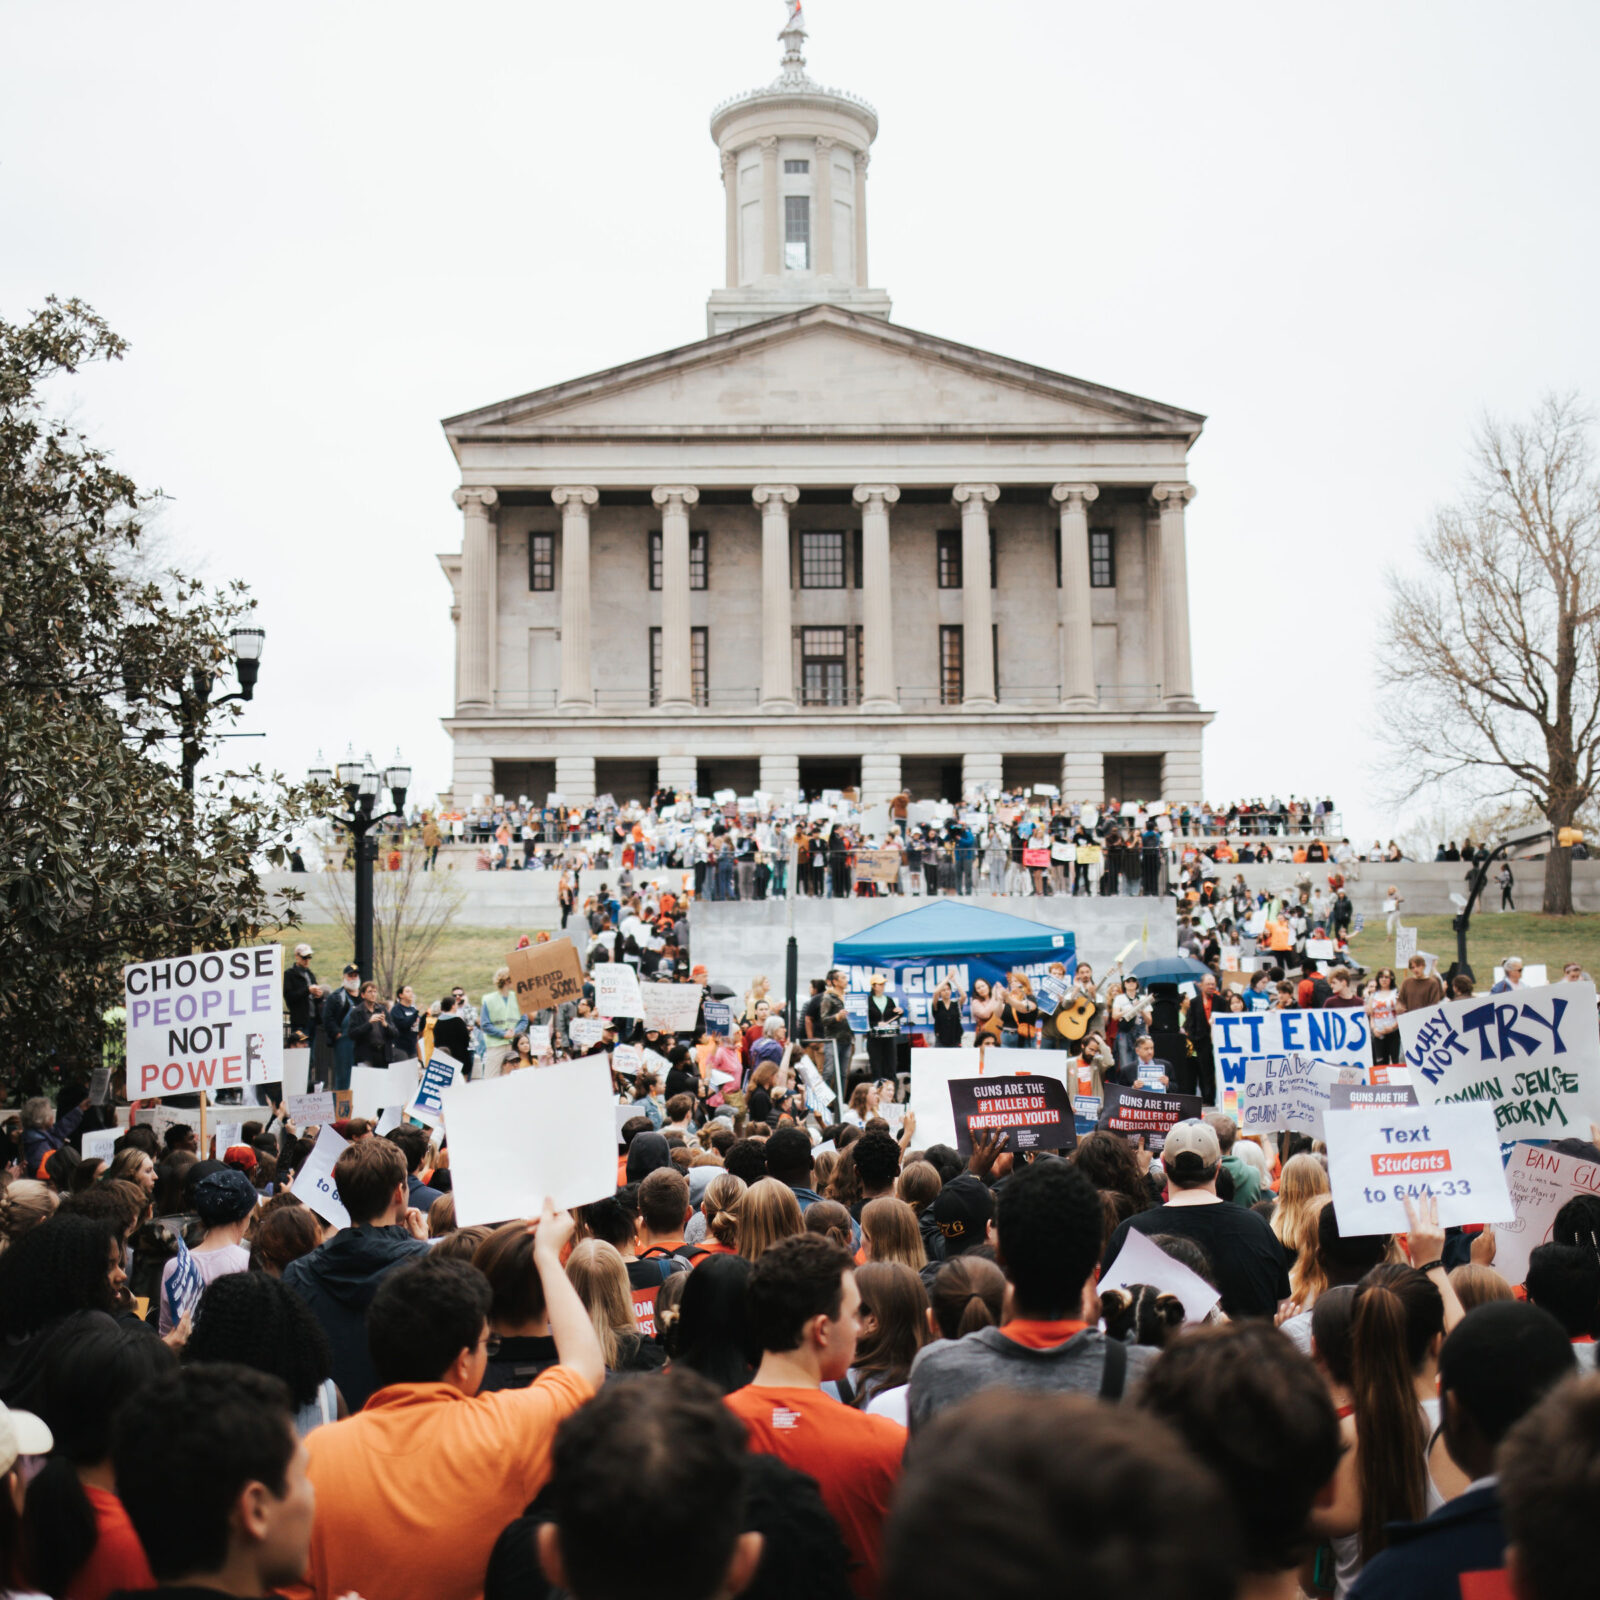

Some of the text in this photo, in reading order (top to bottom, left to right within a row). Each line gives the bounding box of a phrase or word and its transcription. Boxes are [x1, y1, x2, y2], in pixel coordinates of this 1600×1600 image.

[127, 950, 274, 995] CHOOSE
[517, 970, 563, 994] AFRAID
[903, 964, 969, 993] GUN
[132, 984, 271, 1027] PEOPLE
[168, 1023, 232, 1057] NOT
[1215, 1011, 1366, 1053] IT ENDS
[1406, 998, 1568, 1067] WHY TRY
[141, 1033, 267, 1092] POWER
[1266, 1057, 1316, 1078] LAW
[1421, 1030, 1470, 1086] NOT
[974, 1083, 1045, 1098] GUNS ARE THE
[1247, 1081, 1274, 1098] CAR
[1512, 1066, 1578, 1096] SENSE
[980, 1097, 1045, 1111] #1 KILLER OF
[1120, 1094, 1181, 1111] GUNS ARE THE
[1351, 1092, 1409, 1102] GUNS ARE THE
[969, 1110, 1059, 1129] AMERICAN YOUTH
[1109, 1119, 1156, 1131] AMERICAN
[1121, 1108, 1178, 1121] #1 KILLER OF
[1494, 1097, 1568, 1131] EFORM
[1381, 1125, 1431, 1144] Text
[1378, 1155, 1445, 1172] Students
[1526, 1148, 1600, 1191] BAN GU
[317, 1178, 329, 1192] to
[1363, 1180, 1471, 1203] to 644-33
